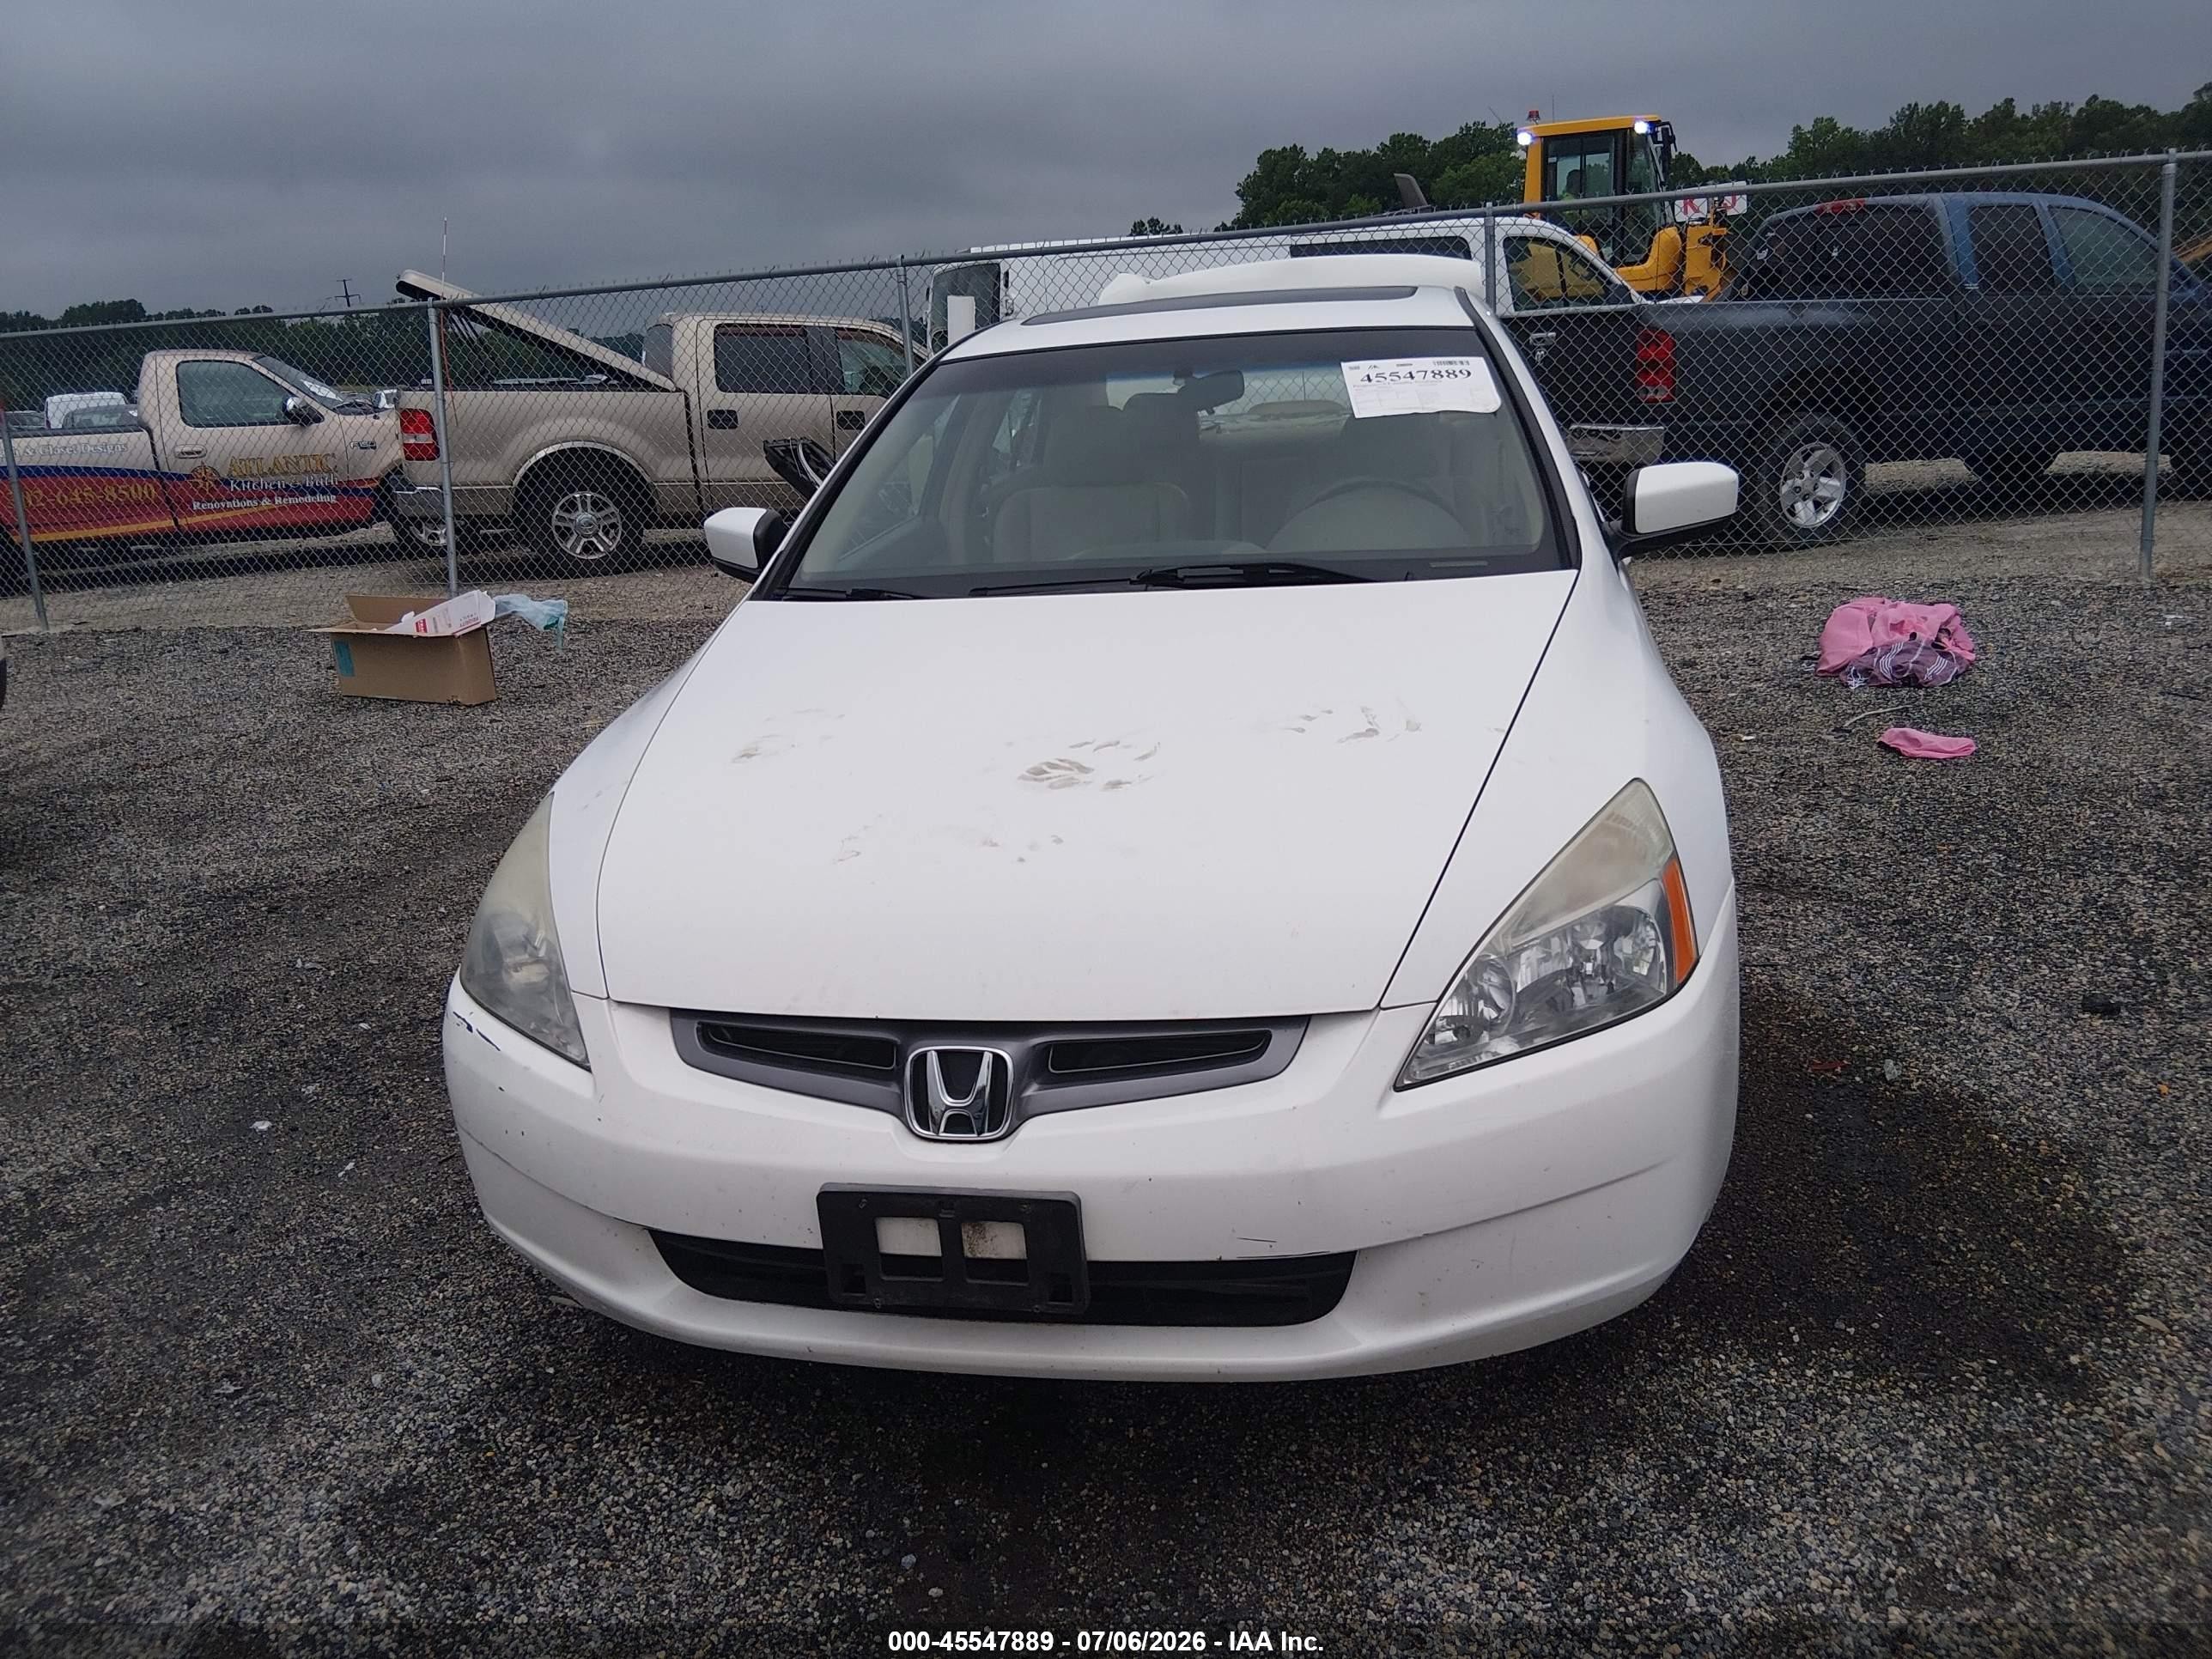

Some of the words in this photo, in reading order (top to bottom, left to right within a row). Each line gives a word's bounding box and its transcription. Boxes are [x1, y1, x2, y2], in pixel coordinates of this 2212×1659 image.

[1360, 369, 1472, 384] 45547889
[82, 442, 128, 454] Designs
[227, 453, 337, 477] ATLANTIC
[230, 478, 287, 492] Kitchen
[306, 473, 338, 487] Bath
[192, 497, 258, 511] Renovations
[260, 497, 273, 506] &
[275, 494, 337, 505] Remodeling
